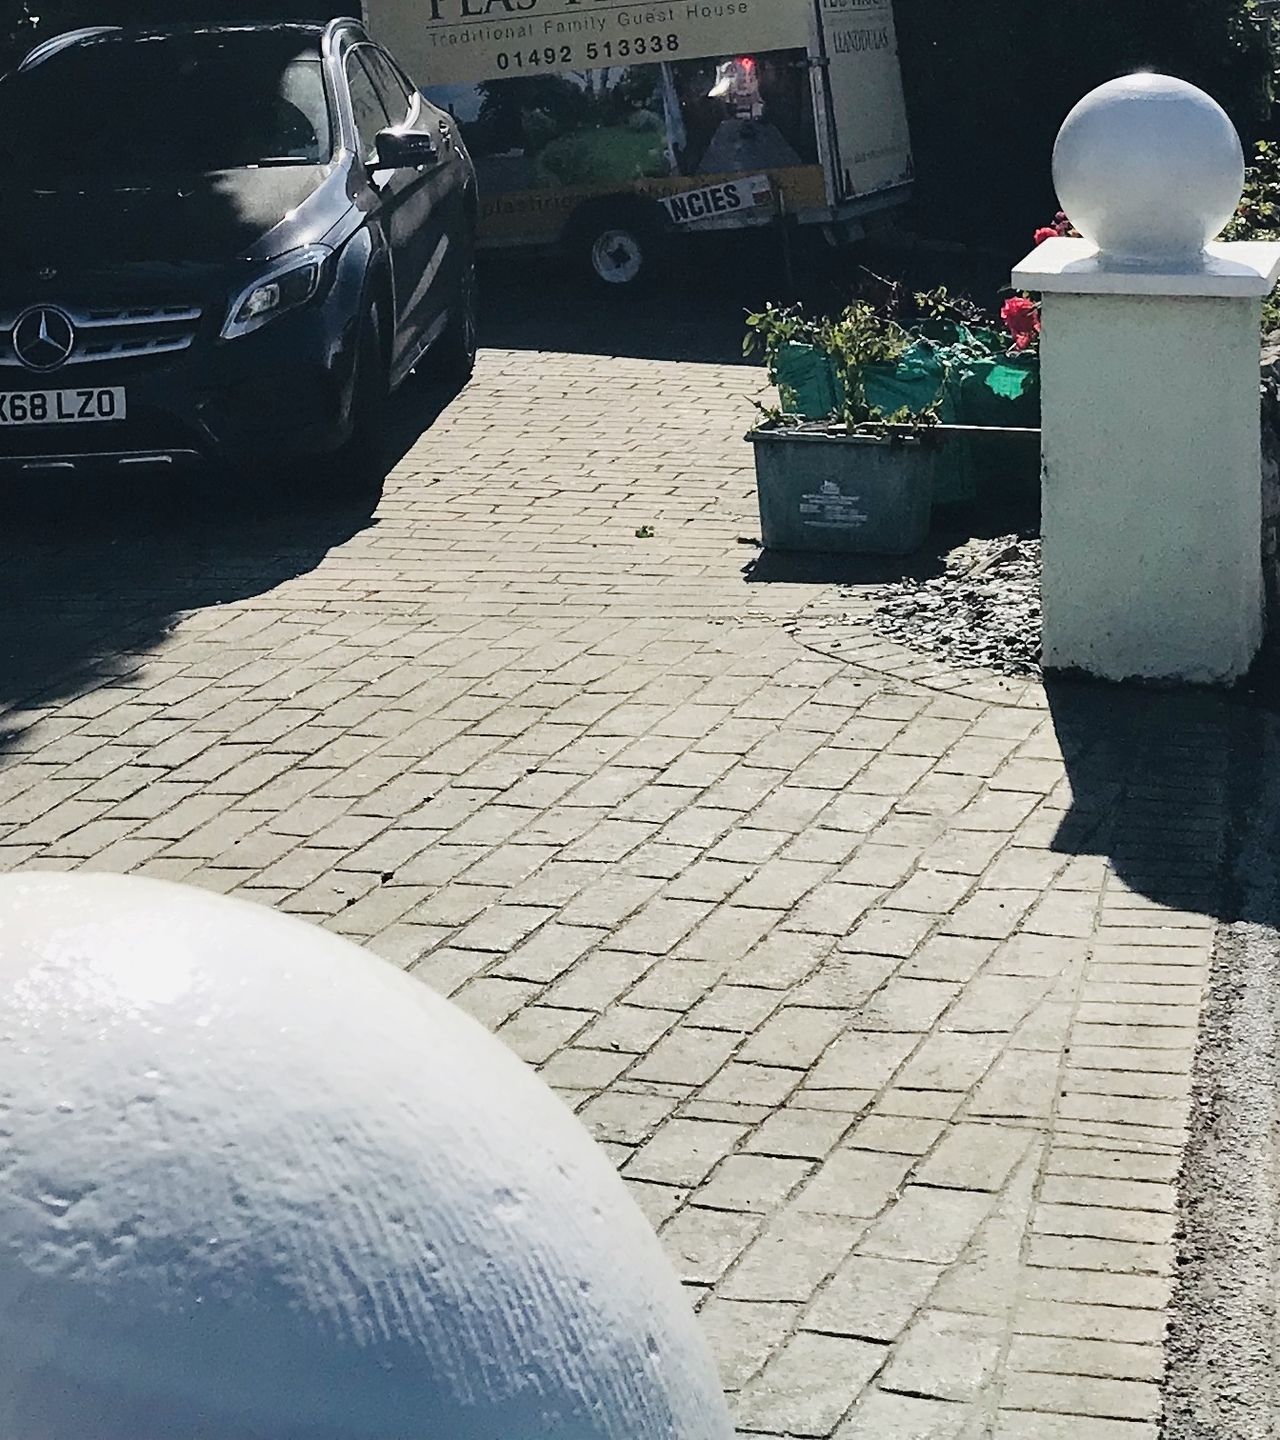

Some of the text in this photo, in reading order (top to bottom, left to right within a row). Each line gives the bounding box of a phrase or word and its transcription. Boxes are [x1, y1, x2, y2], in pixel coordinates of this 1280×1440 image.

[428, 1, 748, 48] Traditional Family Guest House
[497, 34, 680, 70] 01492 513338
[56, 389, 115, 420] LZO
